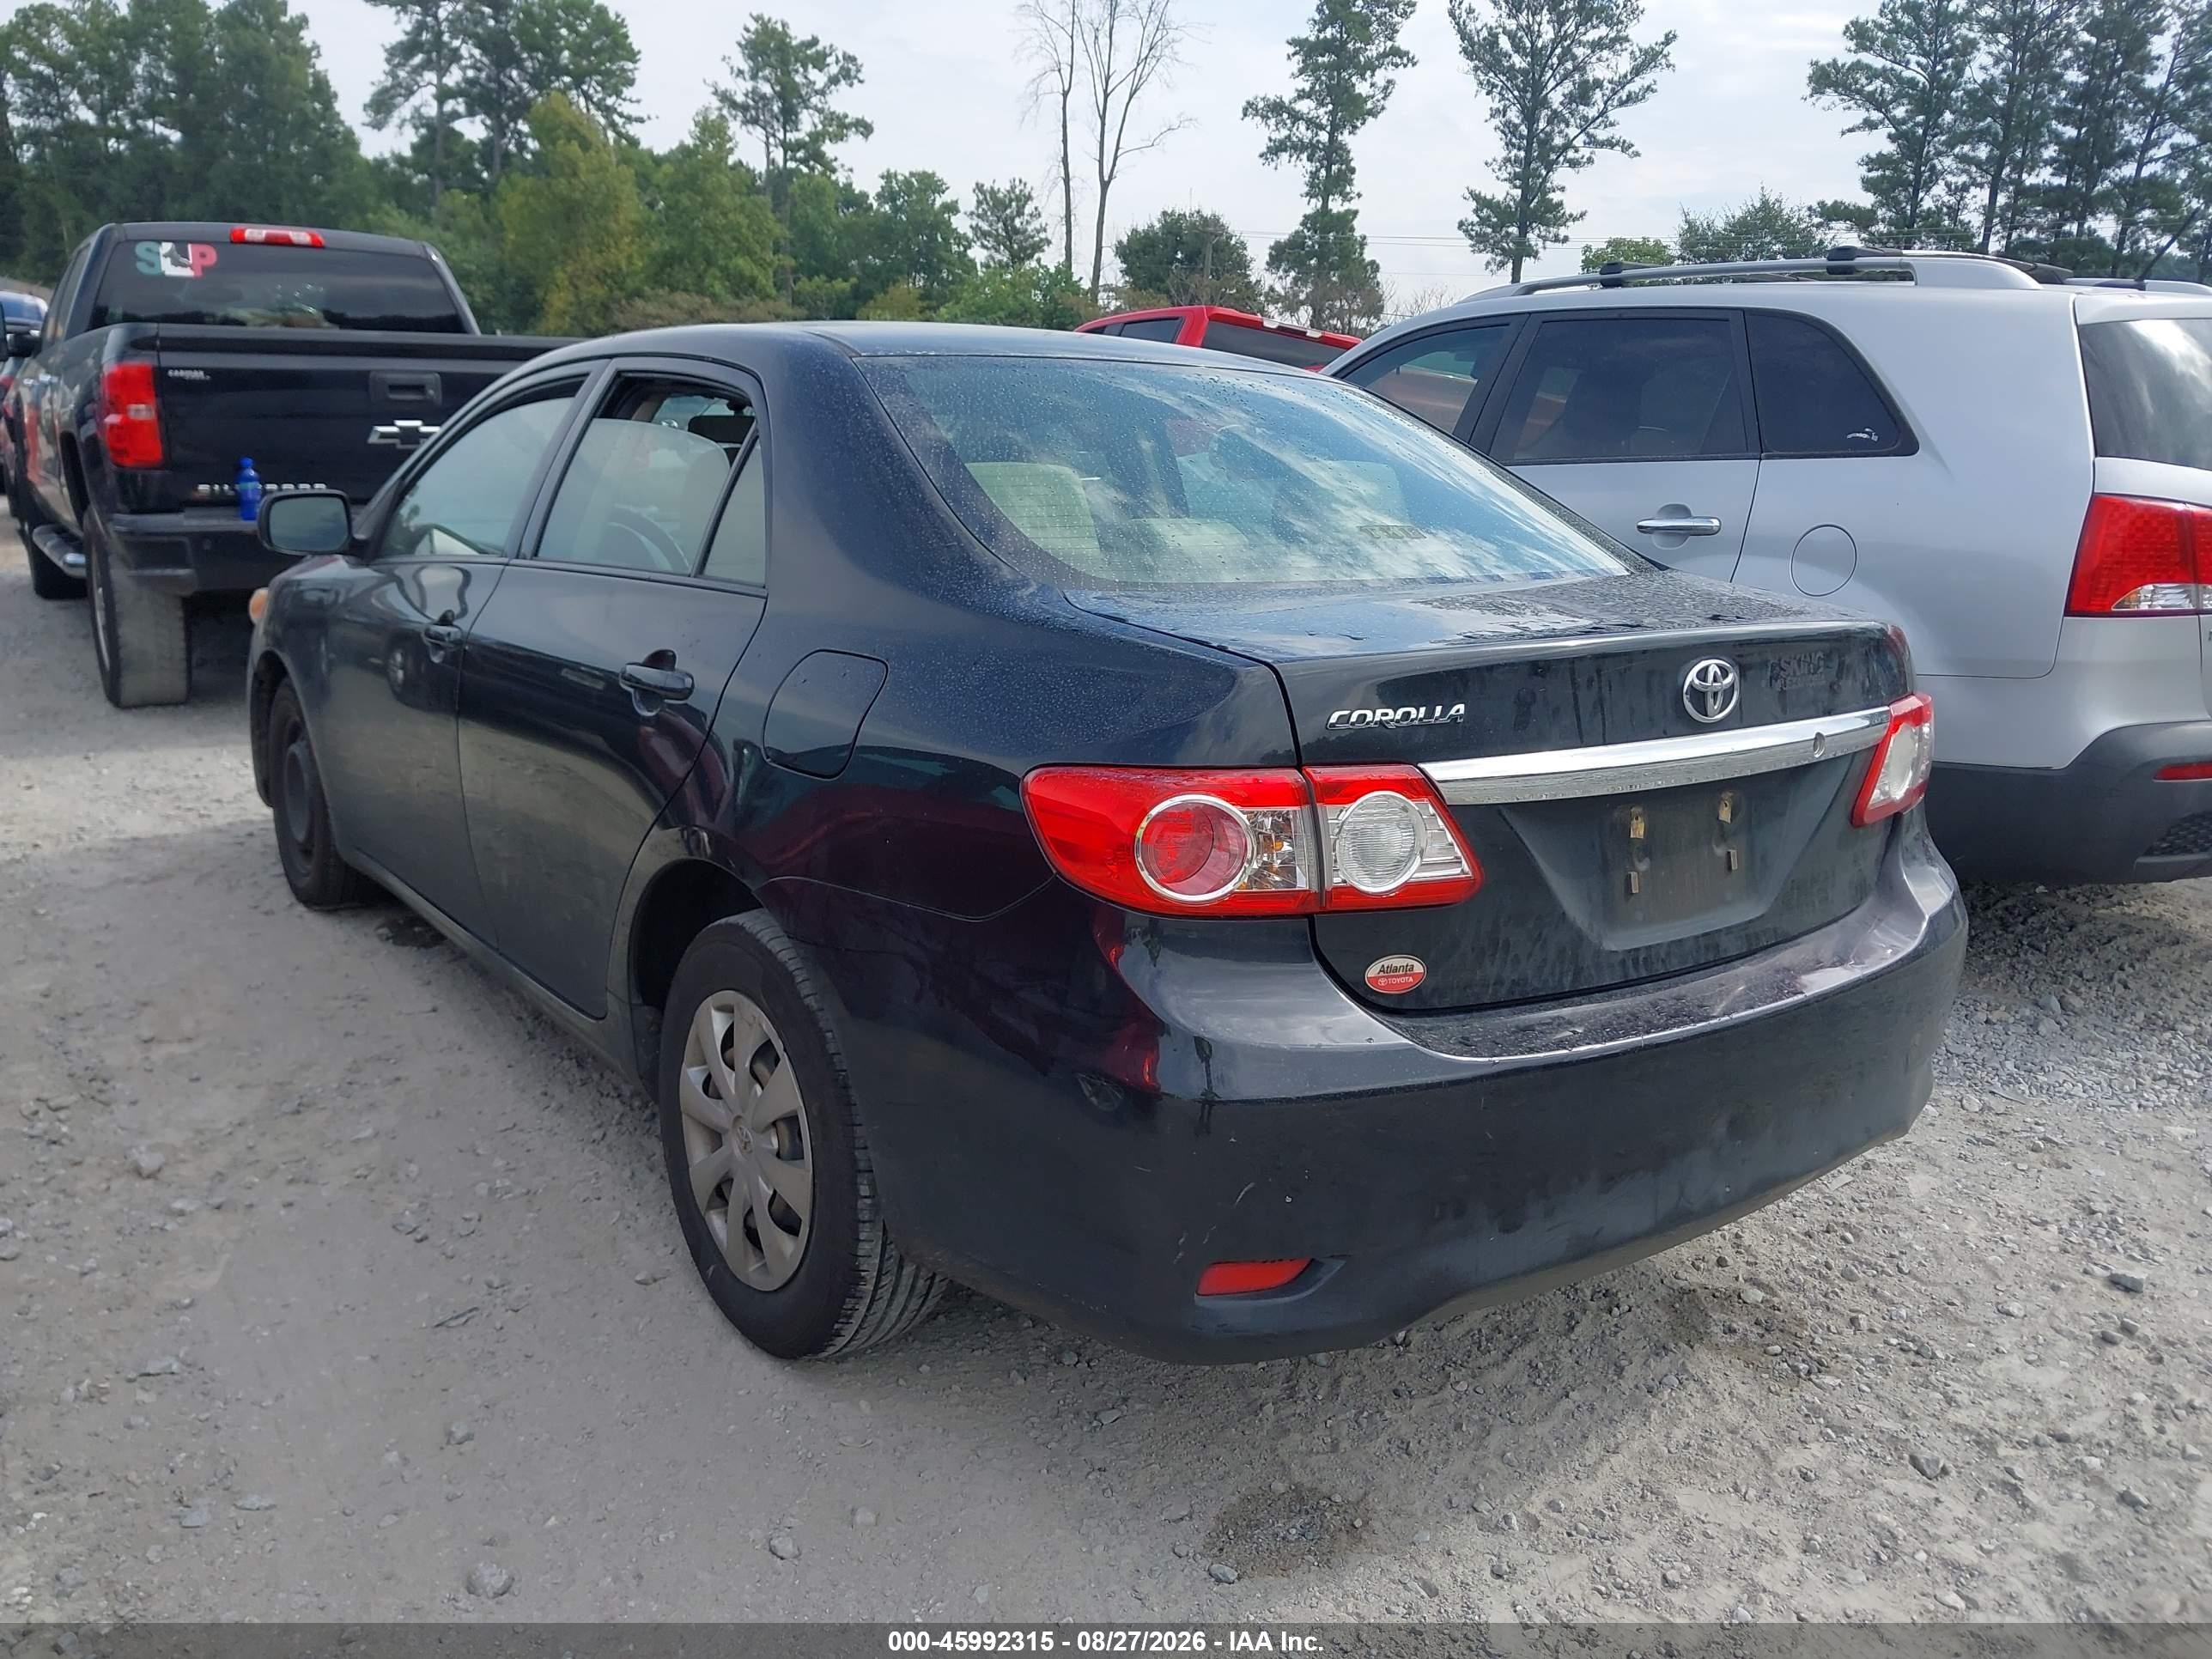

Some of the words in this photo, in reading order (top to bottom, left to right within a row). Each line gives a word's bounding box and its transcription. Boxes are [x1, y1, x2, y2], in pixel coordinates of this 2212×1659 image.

[135, 240, 217, 279] SLP
[1327, 703, 1465, 730] COROLLA
[1377, 963, 1414, 975] Atlanta
